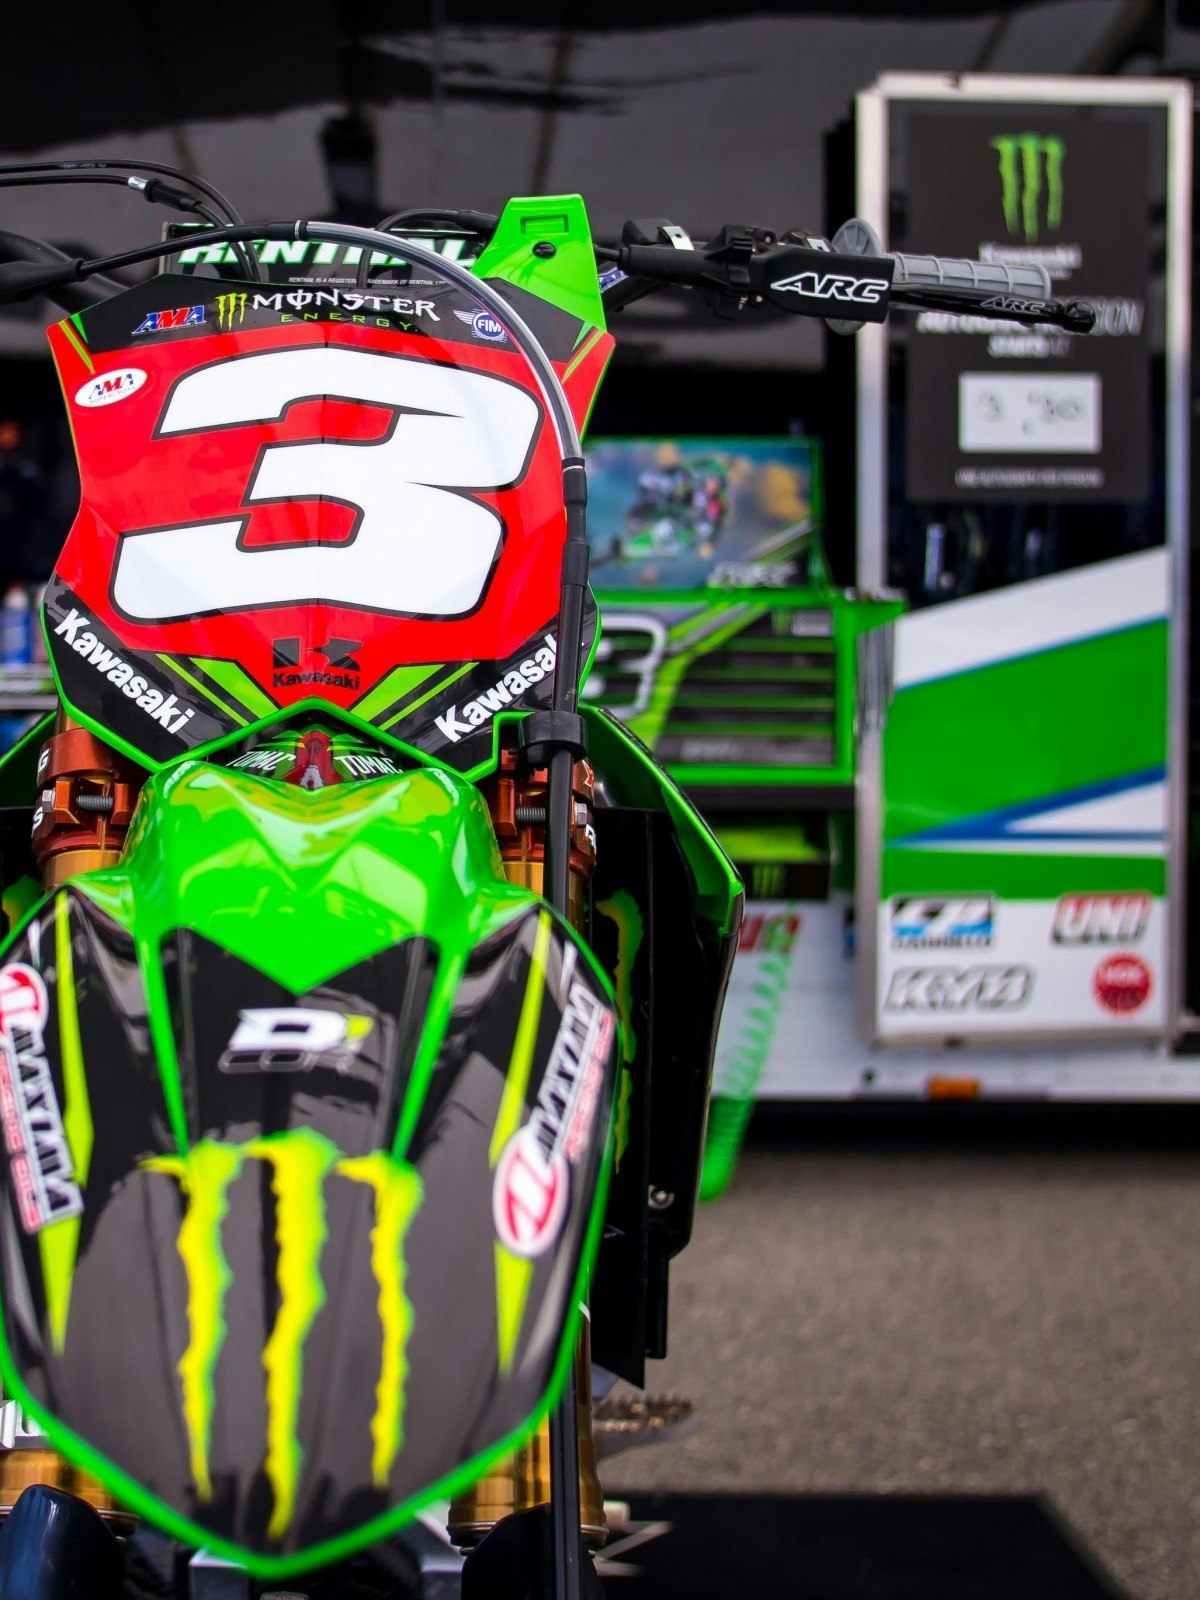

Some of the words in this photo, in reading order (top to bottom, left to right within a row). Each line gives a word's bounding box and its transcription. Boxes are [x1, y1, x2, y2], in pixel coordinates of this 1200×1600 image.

[770, 272, 889, 303] ARC
[253, 288, 441, 322] MONSTER
[981, 296, 1045, 315] ARC
[131, 305, 207, 336] AMA
[281, 312, 413, 331] ENERGY
[477, 319, 503, 334] FIM
[88, 373, 135, 400] AMA
[110, 342, 545, 625] 3
[54, 608, 195, 734] Kawasaki
[273, 671, 360, 690] Kawasaki
[434, 633, 557, 743] Kawasa
[226, 751, 296, 771] TOMAC
[335, 755, 404, 776] TOMAC
